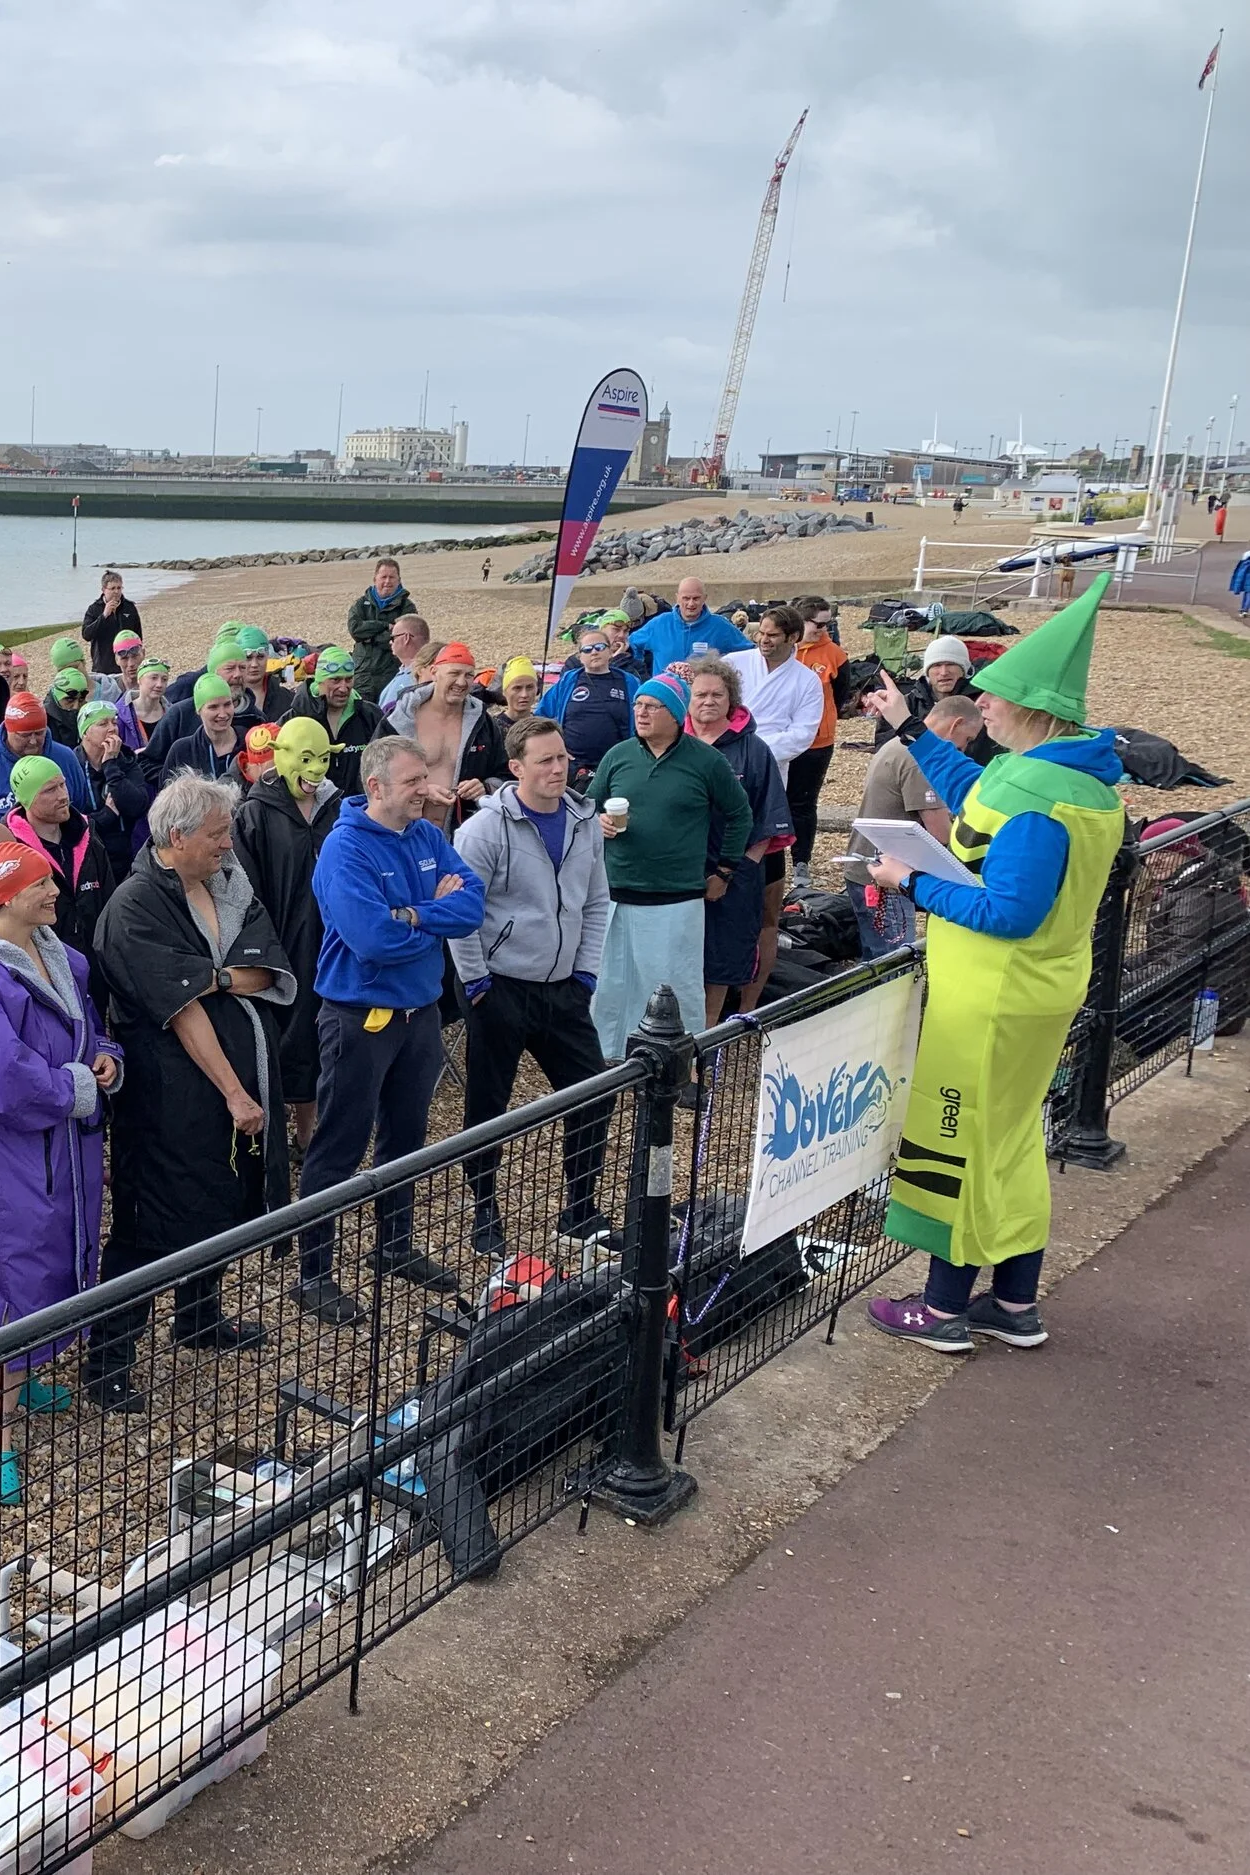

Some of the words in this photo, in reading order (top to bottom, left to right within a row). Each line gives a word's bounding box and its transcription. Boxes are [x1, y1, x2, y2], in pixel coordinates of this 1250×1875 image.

[602, 384, 639, 403] Aspire
[570, 464, 613, 557] www.aspire.org.uk
[762, 1060, 882, 1161] Dover
[940, 1086, 961, 1138] green
[769, 1153, 819, 1198] CHANNEL
[823, 1126, 869, 1168] TRAINING
